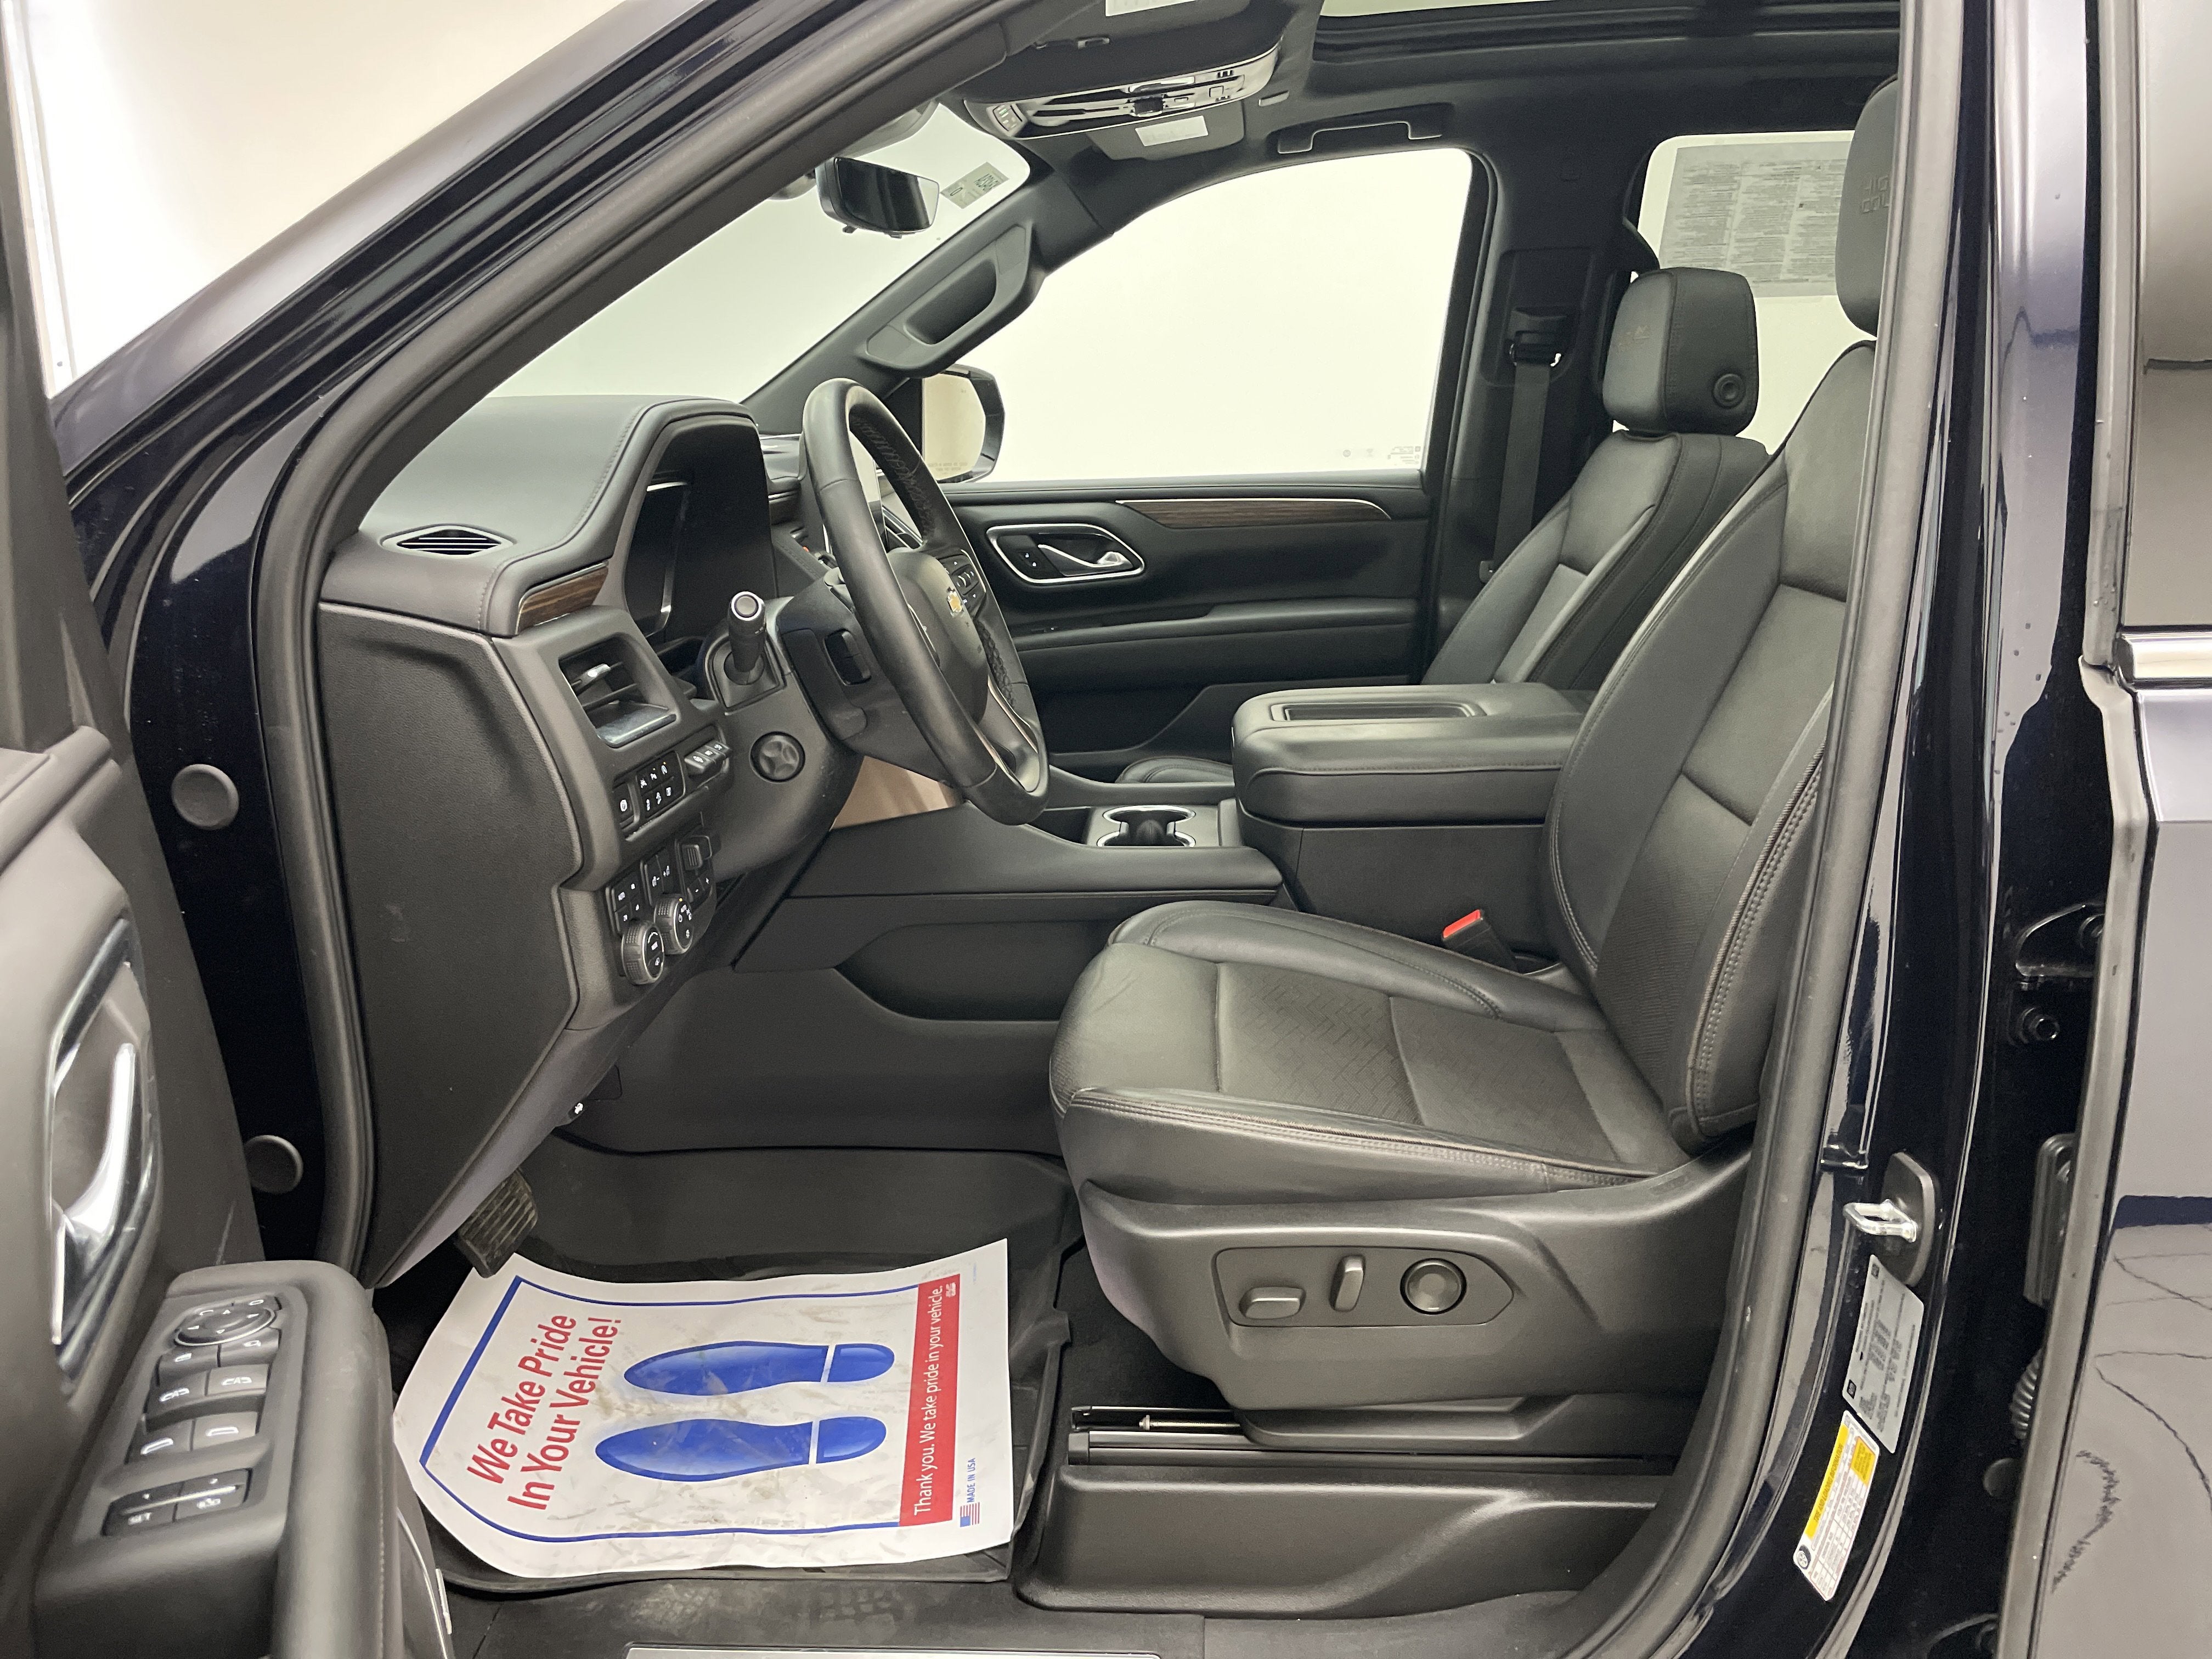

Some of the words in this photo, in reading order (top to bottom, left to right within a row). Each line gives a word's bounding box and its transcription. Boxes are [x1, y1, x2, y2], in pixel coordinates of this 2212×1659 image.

[927, 1285, 943, 1325] vehicle.
[517, 1315, 577, 1377] Pride
[929, 1326, 944, 1347] your
[549, 1317, 622, 1408] Vehicle!
[924, 1351, 940, 1363] in
[923, 1363, 942, 1393] pride
[487, 1381, 546, 1435] Take
[921, 1395, 938, 1421] take
[520, 1413, 580, 1472] Your
[919, 1422, 936, 1443] We
[466, 1438, 518, 1484] We
[921, 1443, 938, 1472] you.
[967, 1457, 976, 1472] USA
[506, 1481, 555, 1510] In
[913, 1472, 934, 1516] Thank
[967, 1482, 975, 1503] MADE
